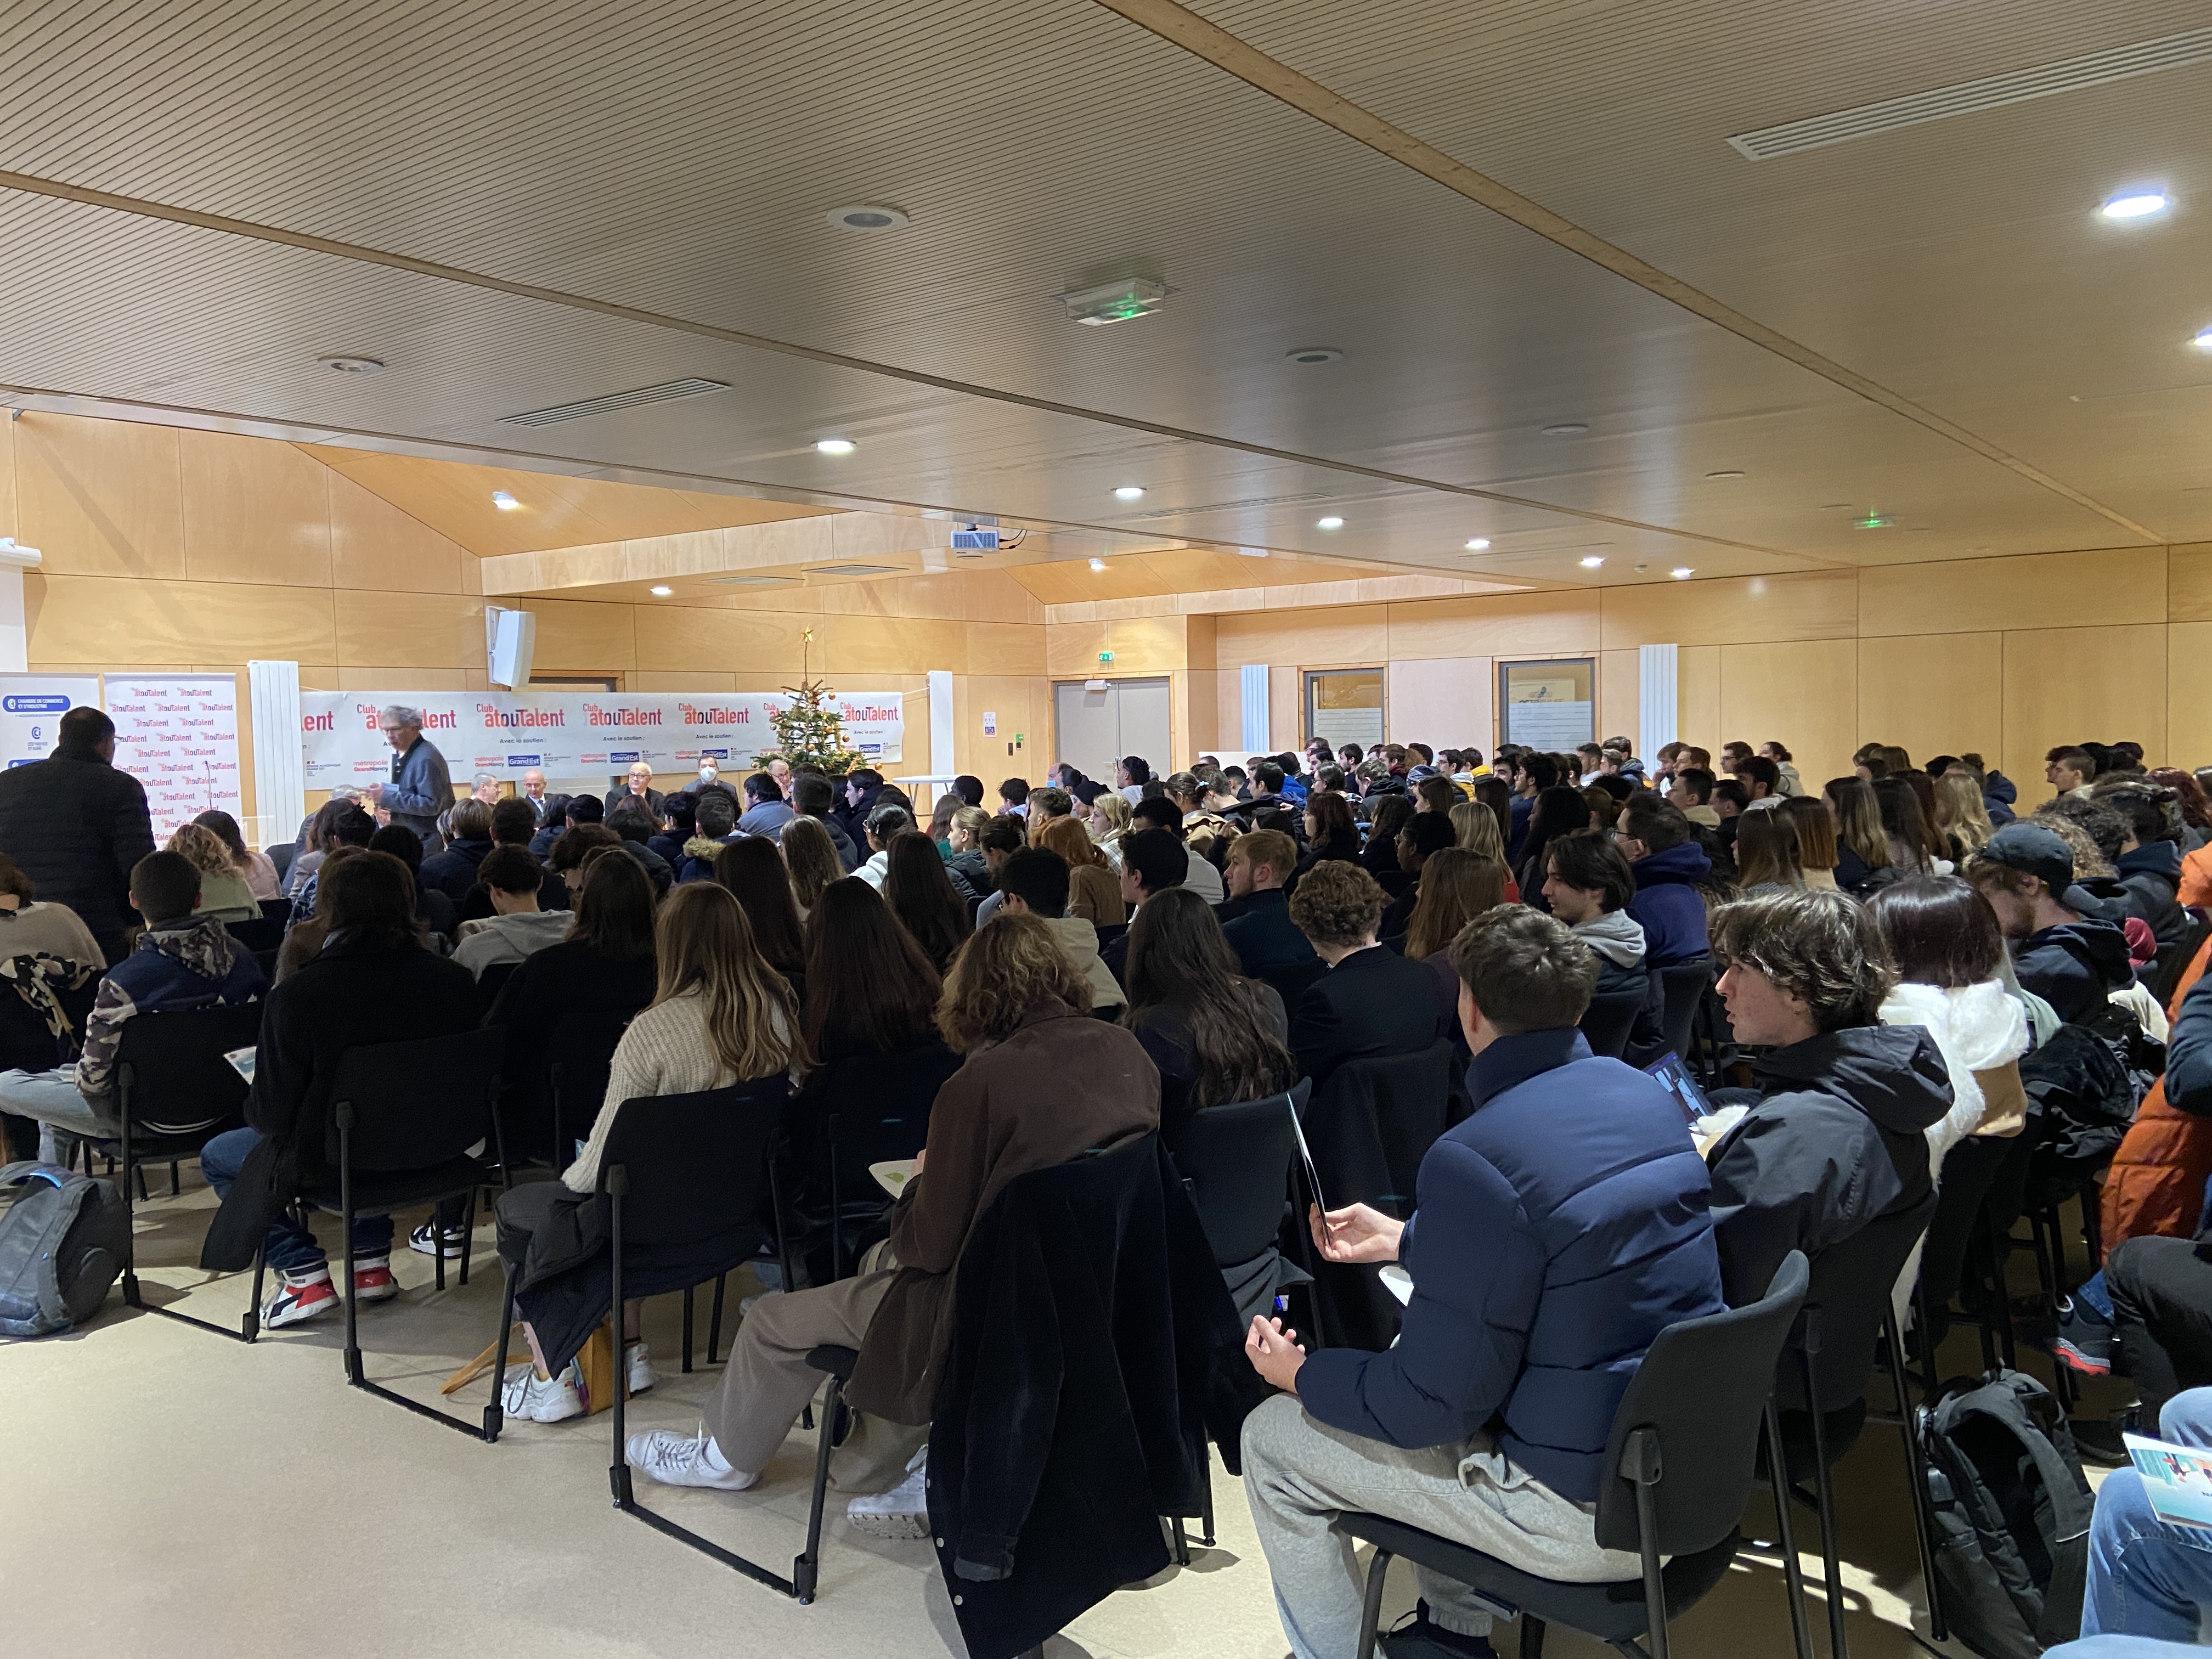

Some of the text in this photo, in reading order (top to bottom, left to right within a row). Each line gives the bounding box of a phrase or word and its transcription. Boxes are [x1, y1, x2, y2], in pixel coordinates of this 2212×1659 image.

[357, 704, 376, 714] Club
[476, 704, 493, 712] Club
[583, 703, 598, 712] Club
[685, 707, 749, 724] atouTalent
[845, 706, 898, 721] atouTalent
[302, 710, 334, 731] ent
[484, 708, 565, 727] atouTalent
[590, 707, 662, 726] atouTalent
